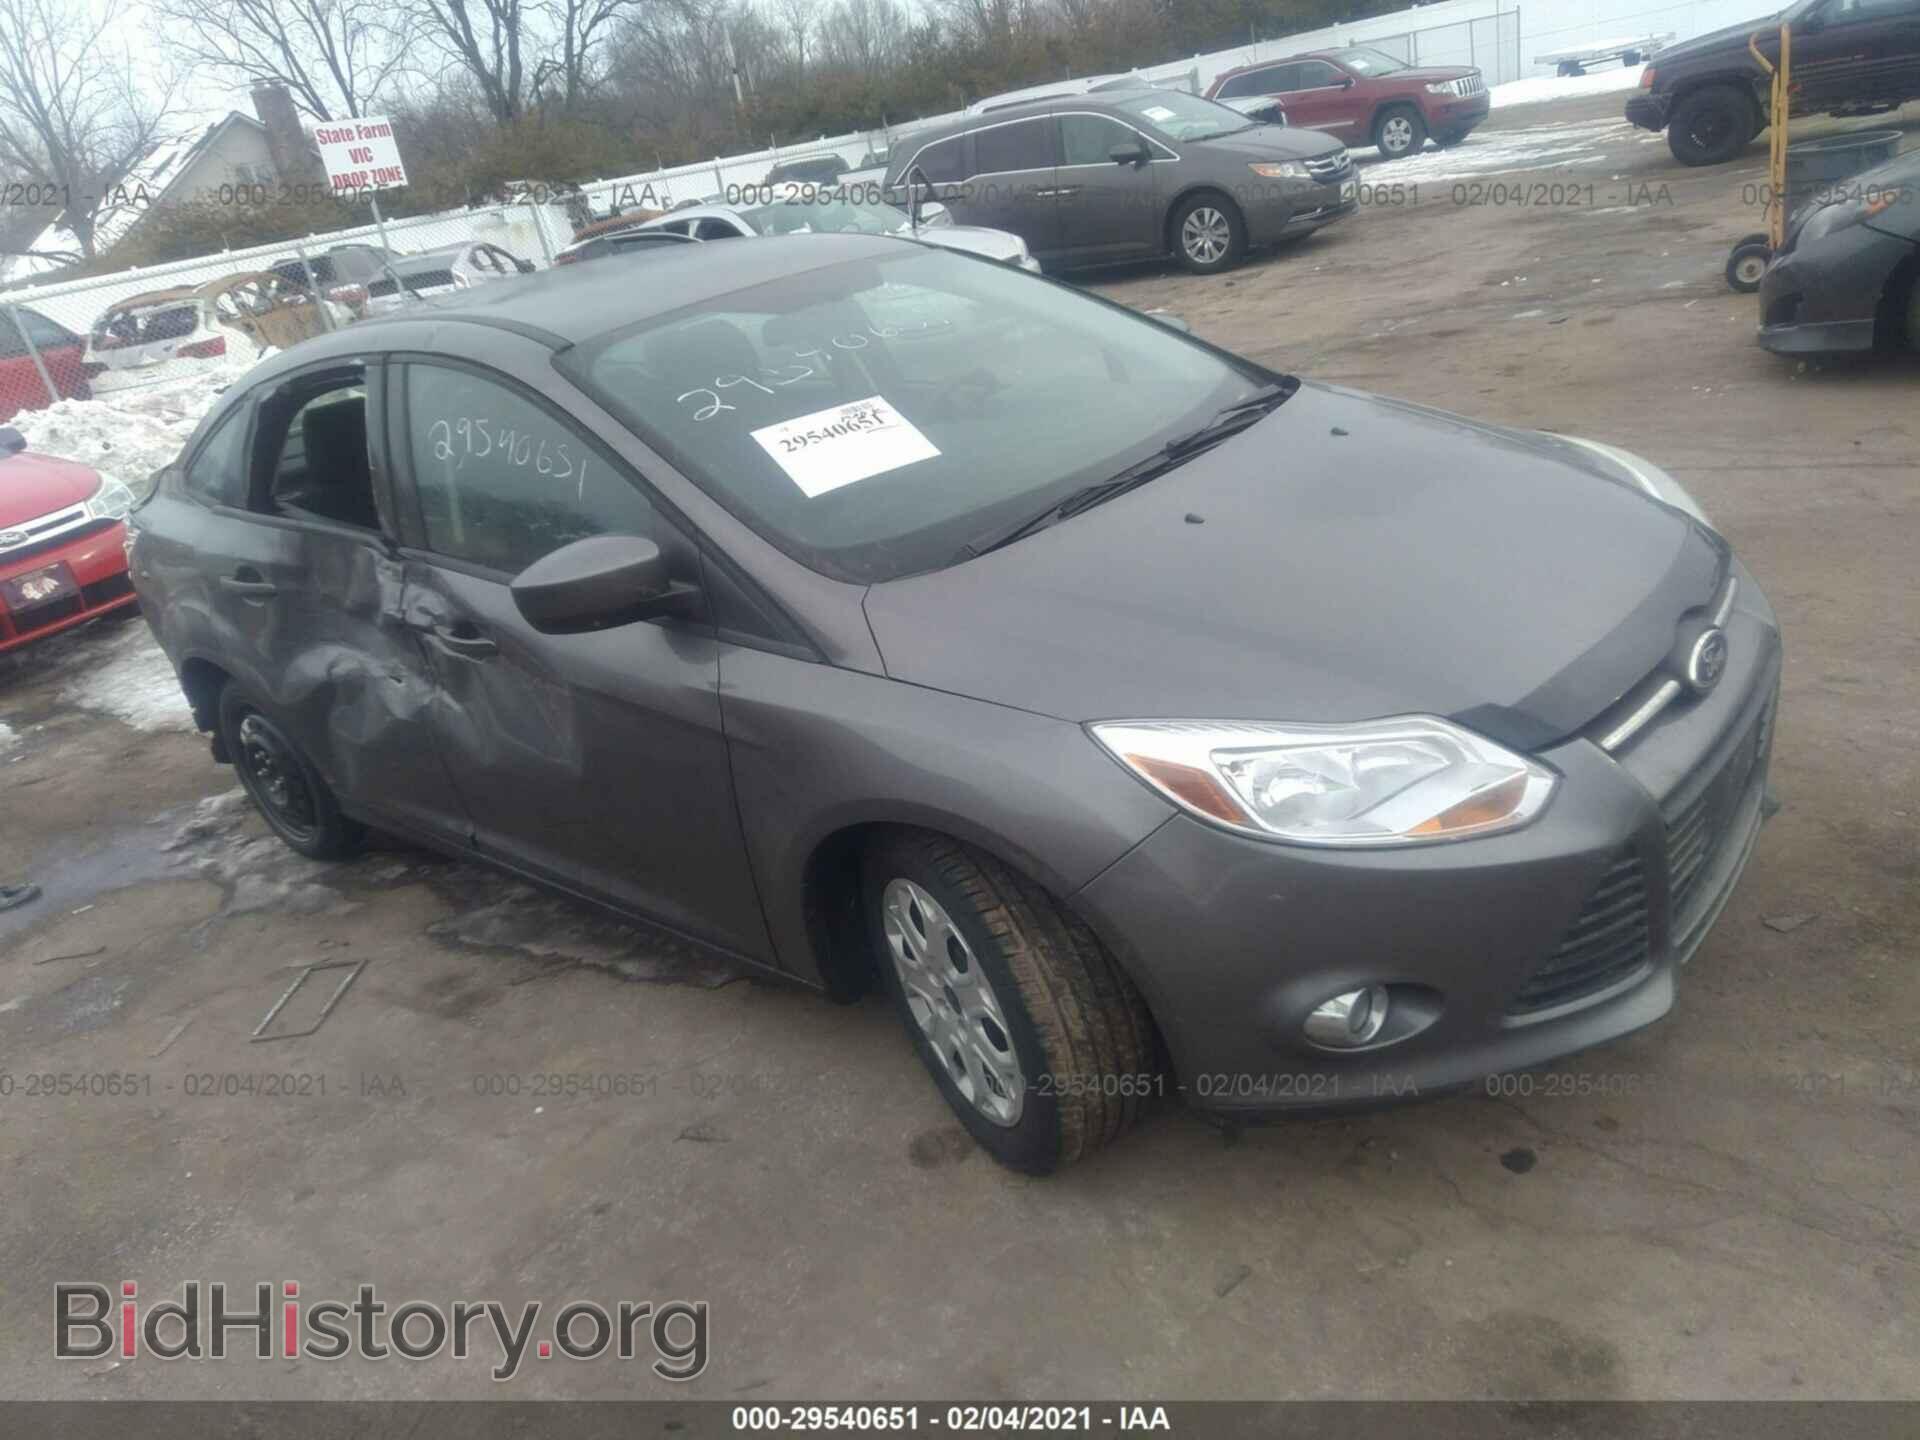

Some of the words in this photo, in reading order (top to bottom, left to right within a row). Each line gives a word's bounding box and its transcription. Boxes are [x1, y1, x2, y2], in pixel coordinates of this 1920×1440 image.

[316, 127, 354, 145] State
[355, 123, 391, 140] Farm
[348, 146, 374, 164] VIC
[332, 171, 369, 190] DROP
[369, 165, 404, 185] ZONE
[779, 408, 886, 453] 29540651
[428, 417, 587, 504] 29540651
